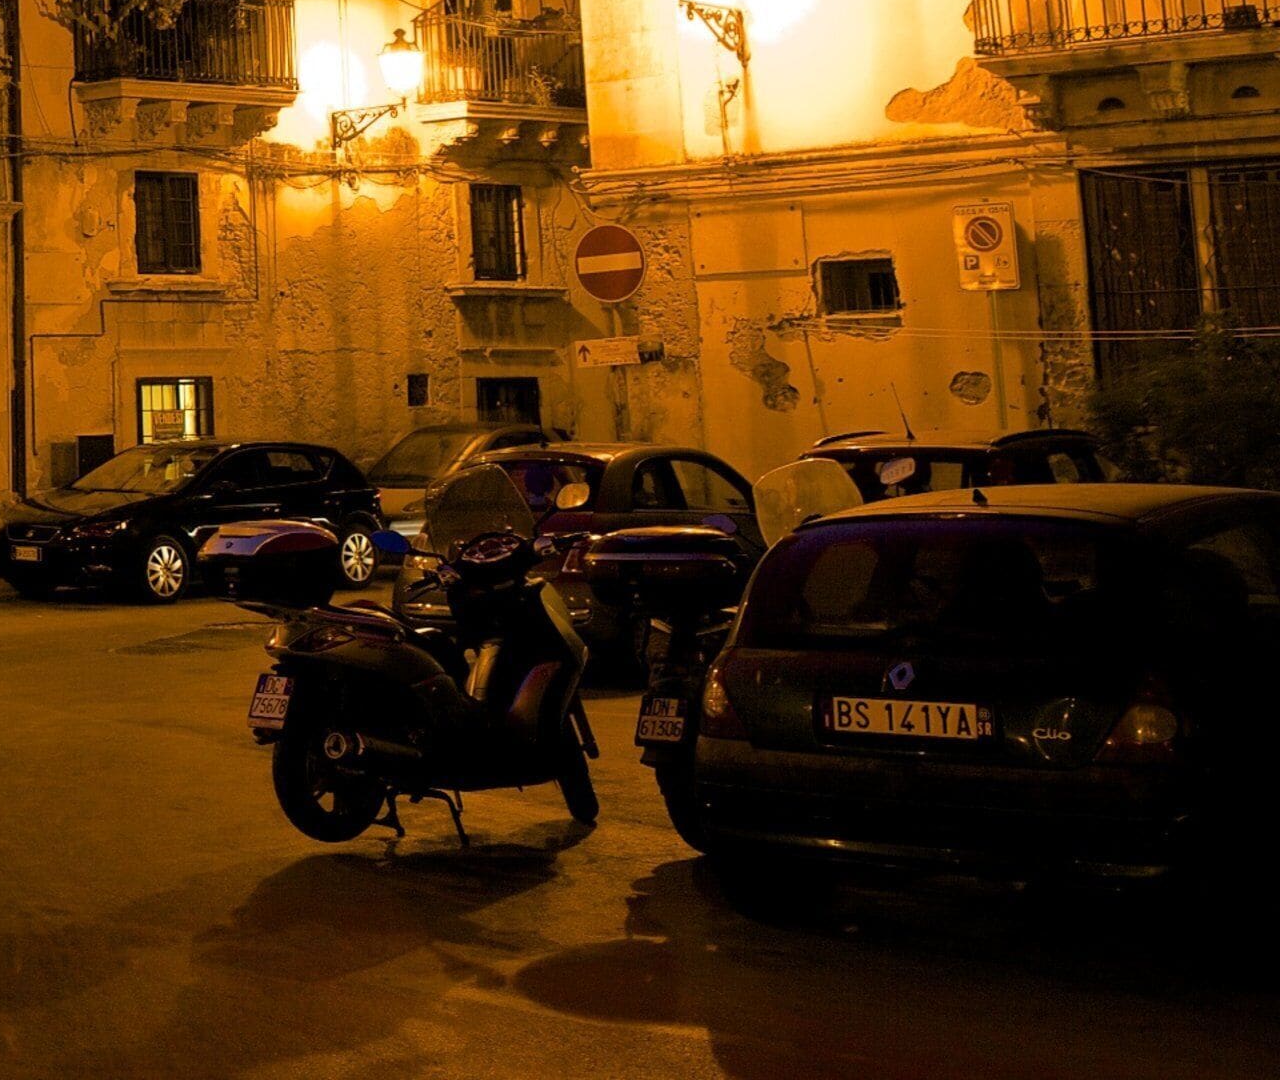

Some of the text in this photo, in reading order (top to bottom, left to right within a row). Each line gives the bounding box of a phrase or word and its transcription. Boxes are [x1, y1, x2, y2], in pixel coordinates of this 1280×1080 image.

[966, 257, 977, 269] P
[837, 700, 870, 729] BS
[885, 703, 972, 736] 141YA
[977, 721, 992, 736] SR
[640, 719, 682, 737] 61306
[1032, 727, 1072, 741] Clio
